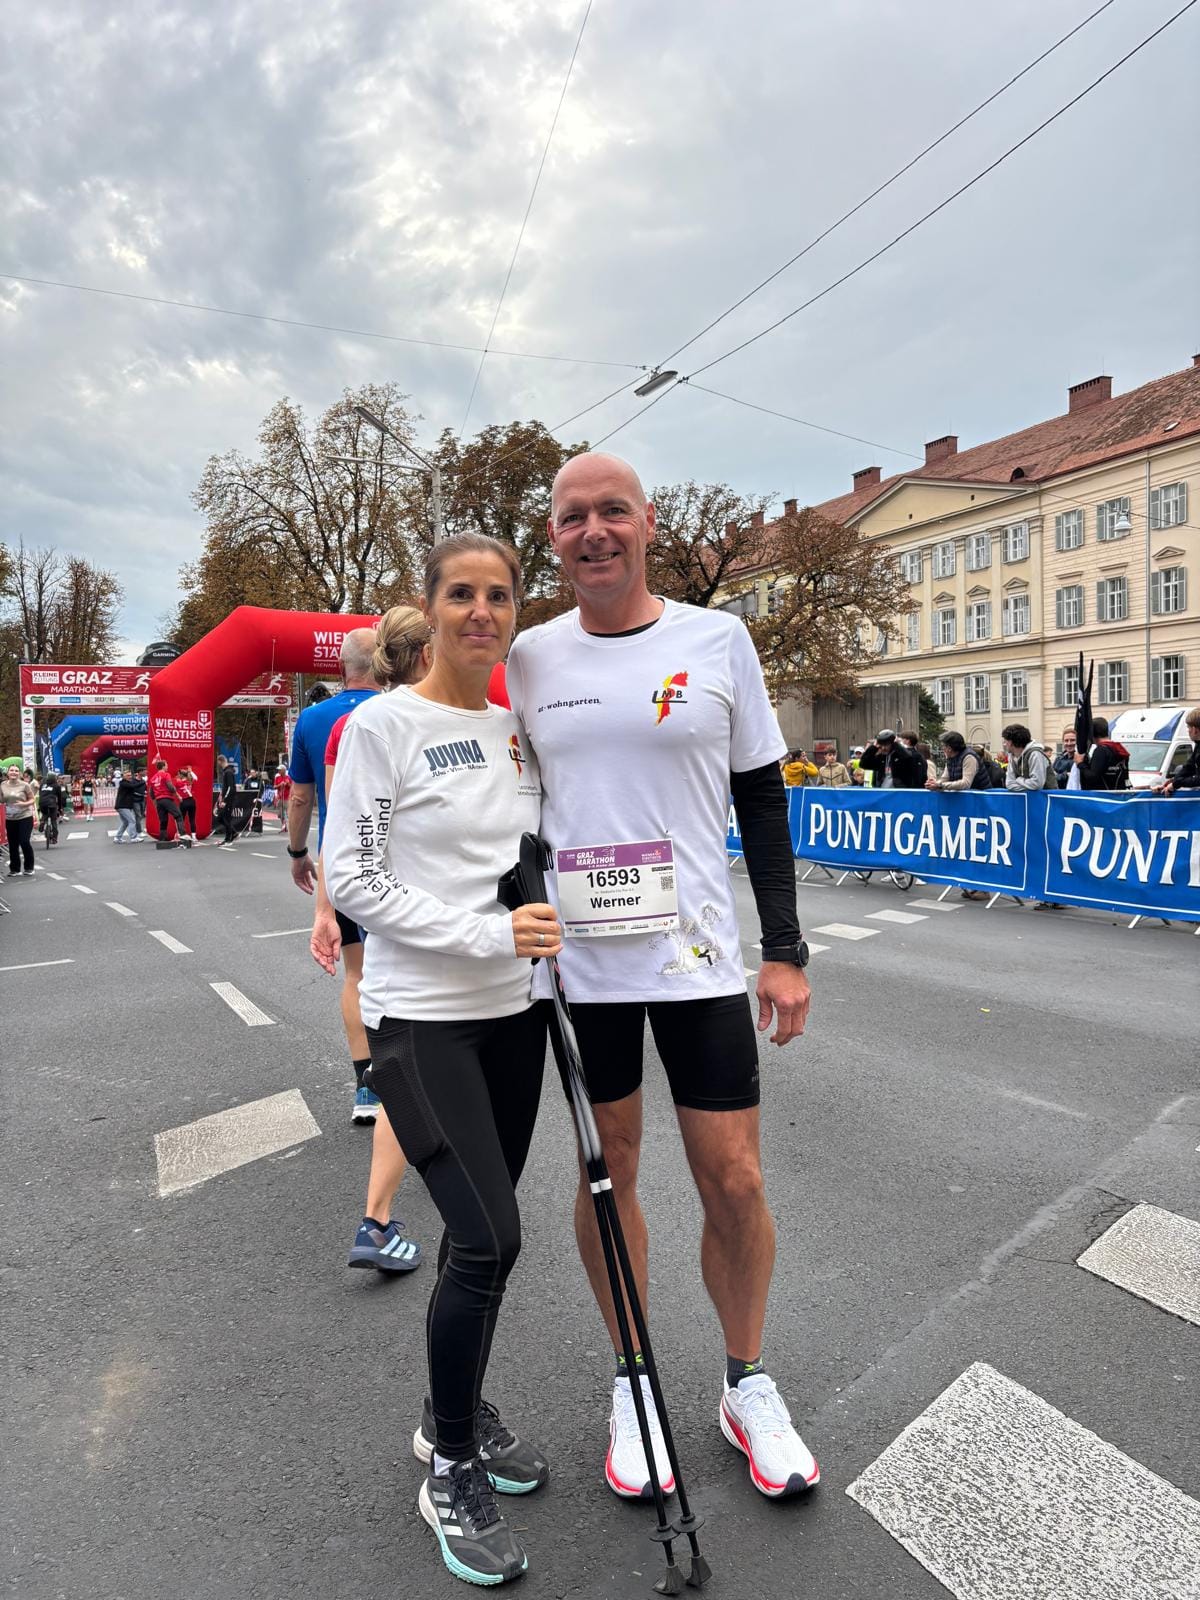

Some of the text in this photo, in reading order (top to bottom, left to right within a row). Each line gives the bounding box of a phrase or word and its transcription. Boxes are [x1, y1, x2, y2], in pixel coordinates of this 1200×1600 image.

[313, 646, 340, 658] STÄ
[62, 670, 113, 685] GRAZ
[103, 724, 149, 733] SPARKA
[155, 718, 197, 729] WIENER
[155, 728, 212, 740] STÄDTISCHE
[423, 739, 486, 771] JUVINA
[808, 803, 1012, 866] PUNTIGAMER
[576, 851, 595, 860] GRAZ
[576, 856, 616, 866] MARATHON
[587, 868, 641, 888] 16593
[590, 895, 641, 909] Werner
